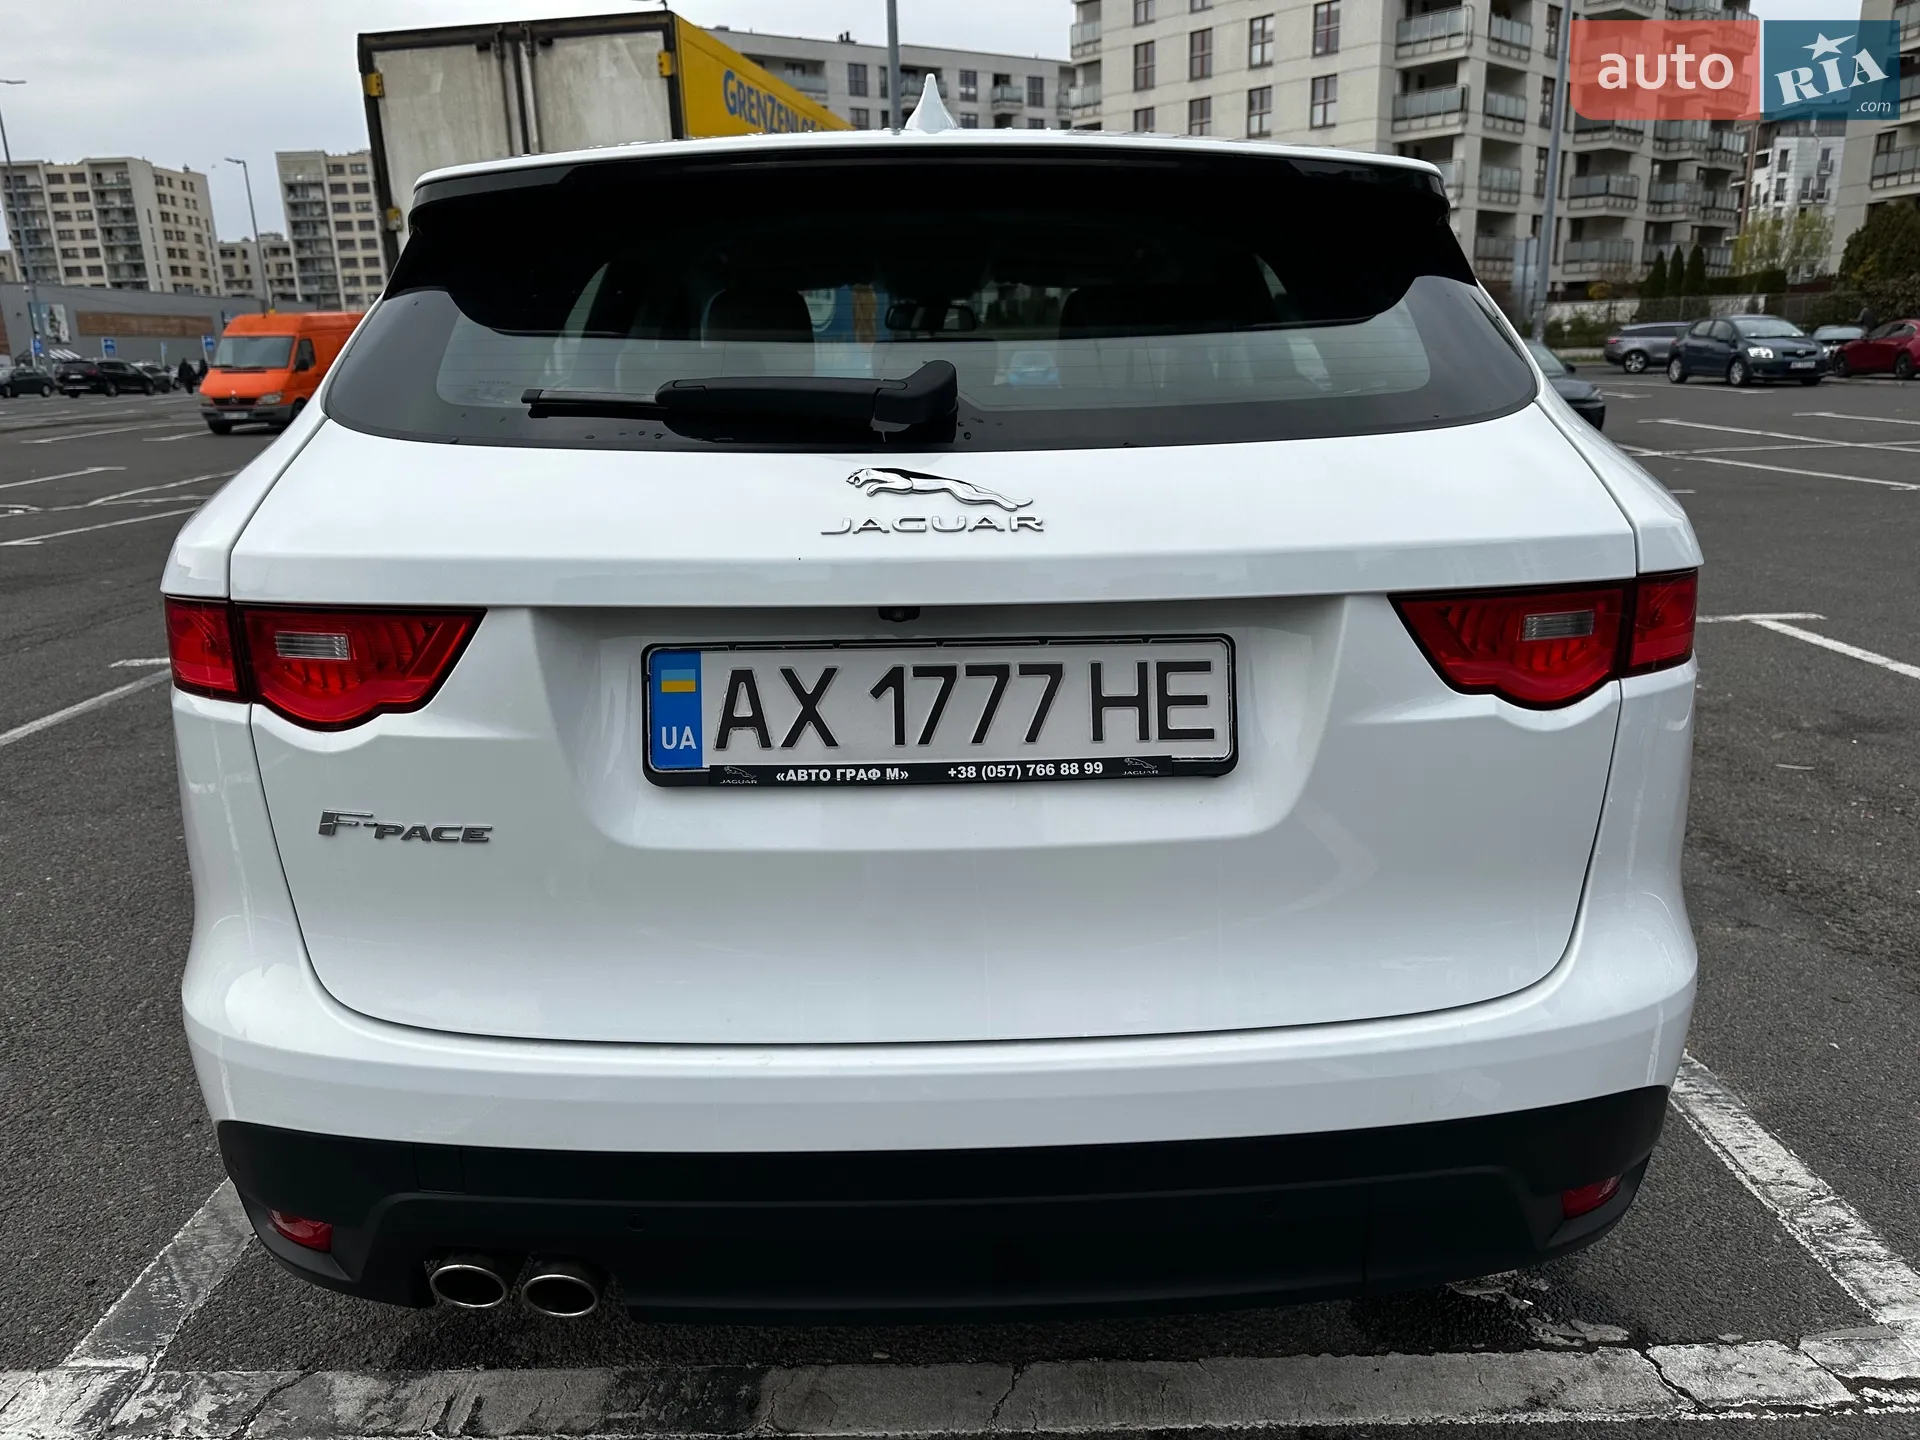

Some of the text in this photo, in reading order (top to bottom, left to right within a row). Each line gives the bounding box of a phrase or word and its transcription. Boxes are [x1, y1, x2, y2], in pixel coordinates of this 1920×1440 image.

[820, 515, 1045, 535] JAGUAR
[714, 660, 1215, 750] AX 1777 HE
[661, 726, 697, 750] UA
[836, 768, 881, 782] ГРАФ
[948, 761, 1104, 781] +38 (057) 766 88 99
[318, 809, 493, 843] F-PACE
